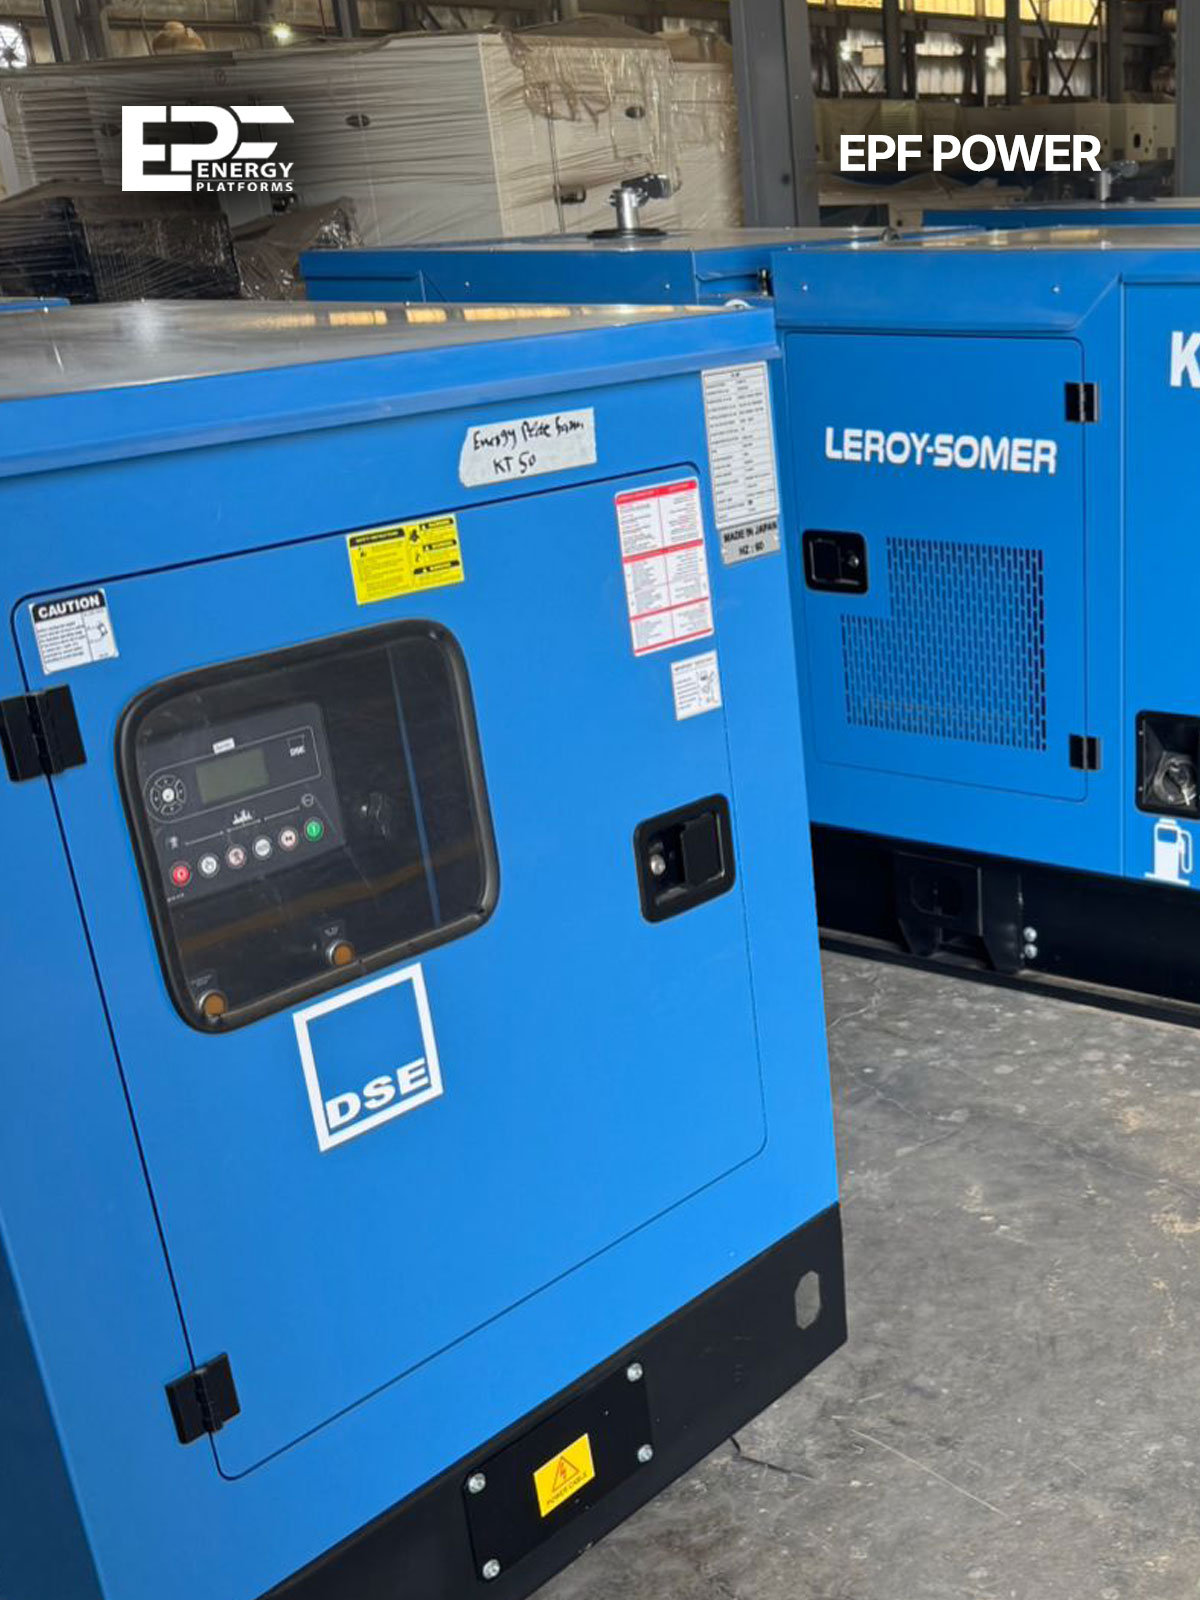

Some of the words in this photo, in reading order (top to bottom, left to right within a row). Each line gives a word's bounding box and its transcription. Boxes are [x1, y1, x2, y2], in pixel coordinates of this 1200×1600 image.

[825, 427, 1057, 475] LEROY-SOMER
[493, 456, 514, 475] KT
[723, 529, 745, 543] MADE
[755, 522, 777, 536] JAPAN
[38, 594, 100, 618] CAUTION
[325, 1057, 429, 1129] DSE
